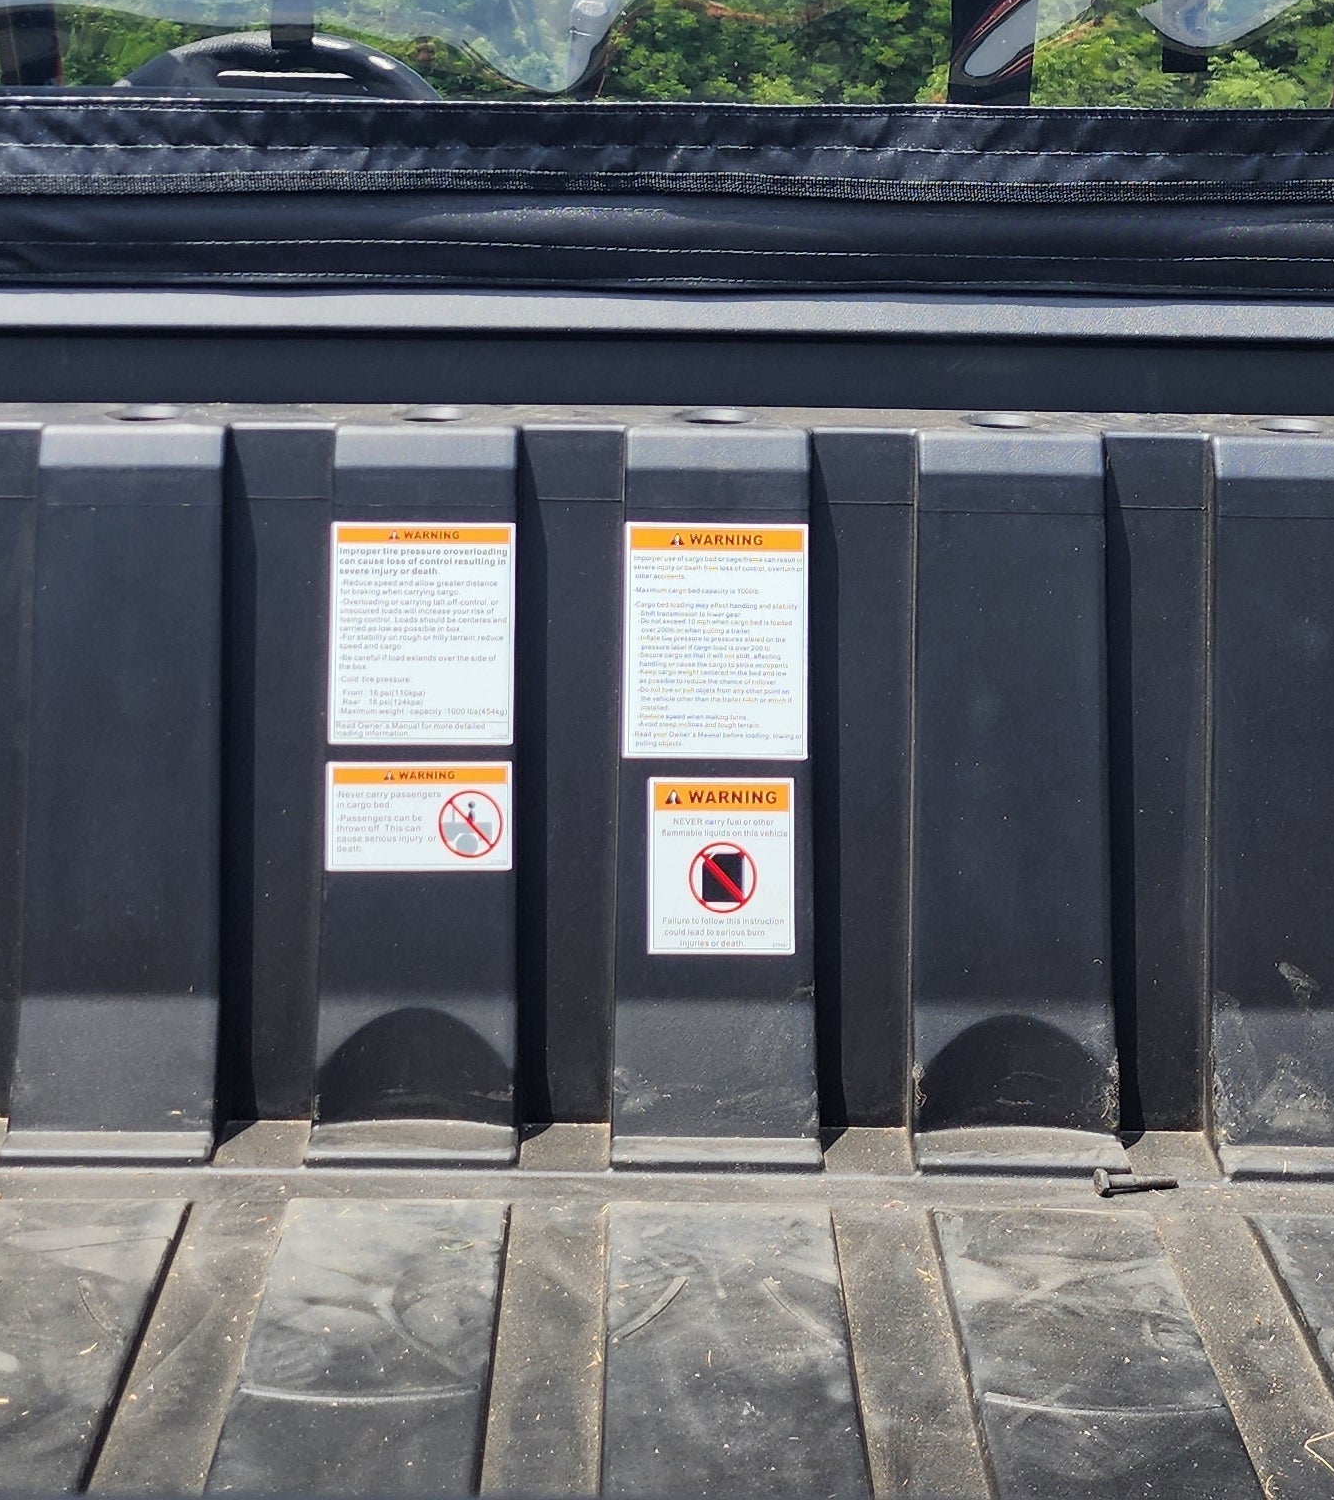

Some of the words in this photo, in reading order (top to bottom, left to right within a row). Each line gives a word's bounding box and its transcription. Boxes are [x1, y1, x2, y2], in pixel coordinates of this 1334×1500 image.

[404, 531, 459, 539] WARNING
[690, 535, 763, 545] WARNING
[372, 568, 398, 576] injury
[399, 771, 455, 779] WARNING
[366, 792, 388, 800] carry
[391, 792, 441, 800] passengers
[689, 791, 777, 804] WARNING
[705, 830, 730, 838] liquids
[399, 836, 424, 844] injury
